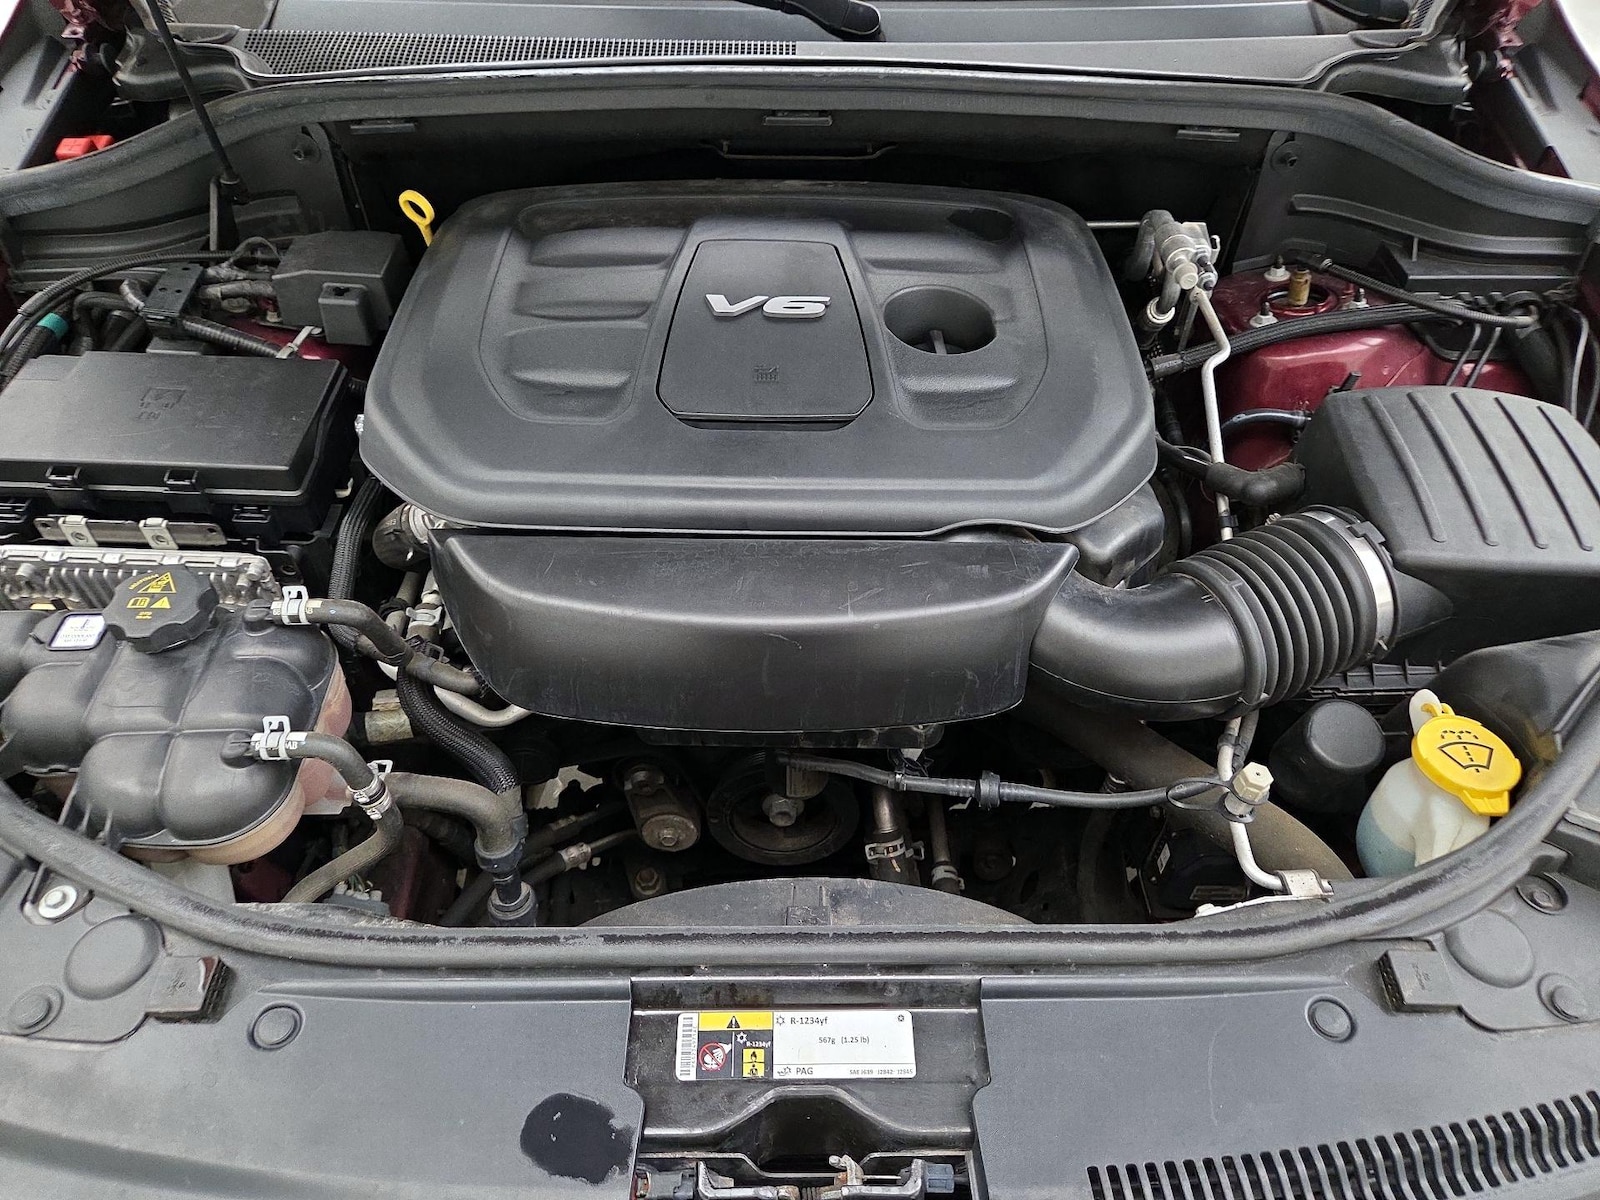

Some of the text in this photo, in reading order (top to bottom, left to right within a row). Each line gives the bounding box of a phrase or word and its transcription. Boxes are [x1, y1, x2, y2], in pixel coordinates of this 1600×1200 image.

[705, 294, 831, 318] V6
[790, 1016, 828, 1026] R-1234yf
[746, 1040, 771, 1048] R-1234yf
[818, 1036, 870, 1045] 567g (1.25 lb)
[796, 1066, 814, 1075] PAG
